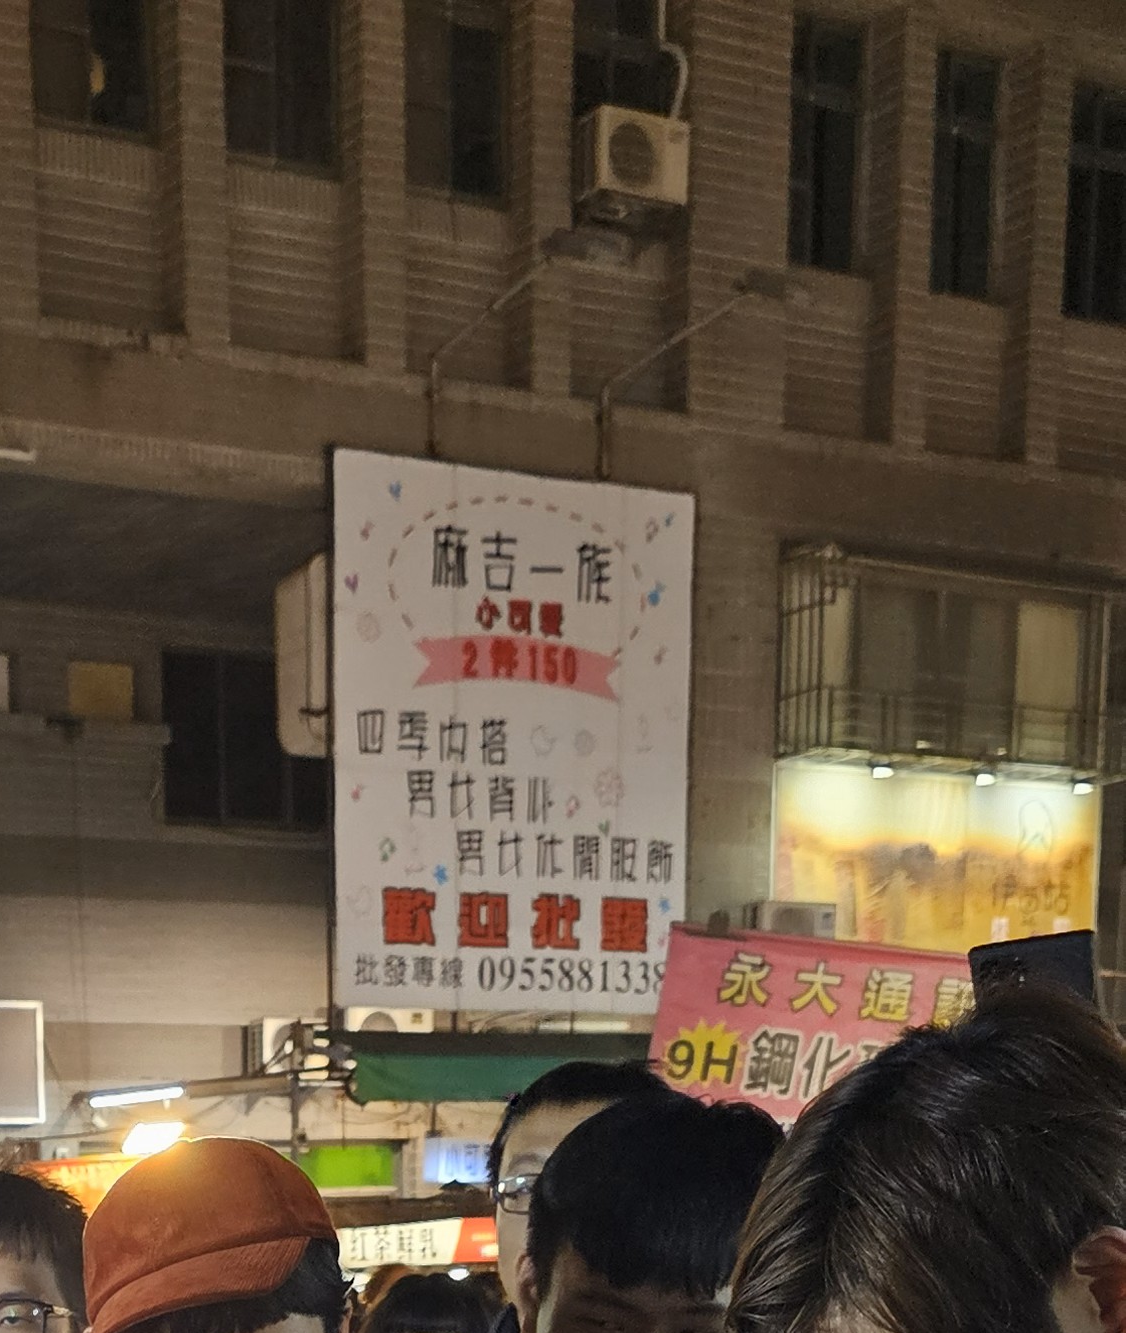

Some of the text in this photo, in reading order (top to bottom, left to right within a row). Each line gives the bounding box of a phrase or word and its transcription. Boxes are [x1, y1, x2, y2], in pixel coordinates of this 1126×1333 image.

[382, 887, 648, 952] 歡迎批發
[667, 1028, 879, 1099] 9H 鋼化
